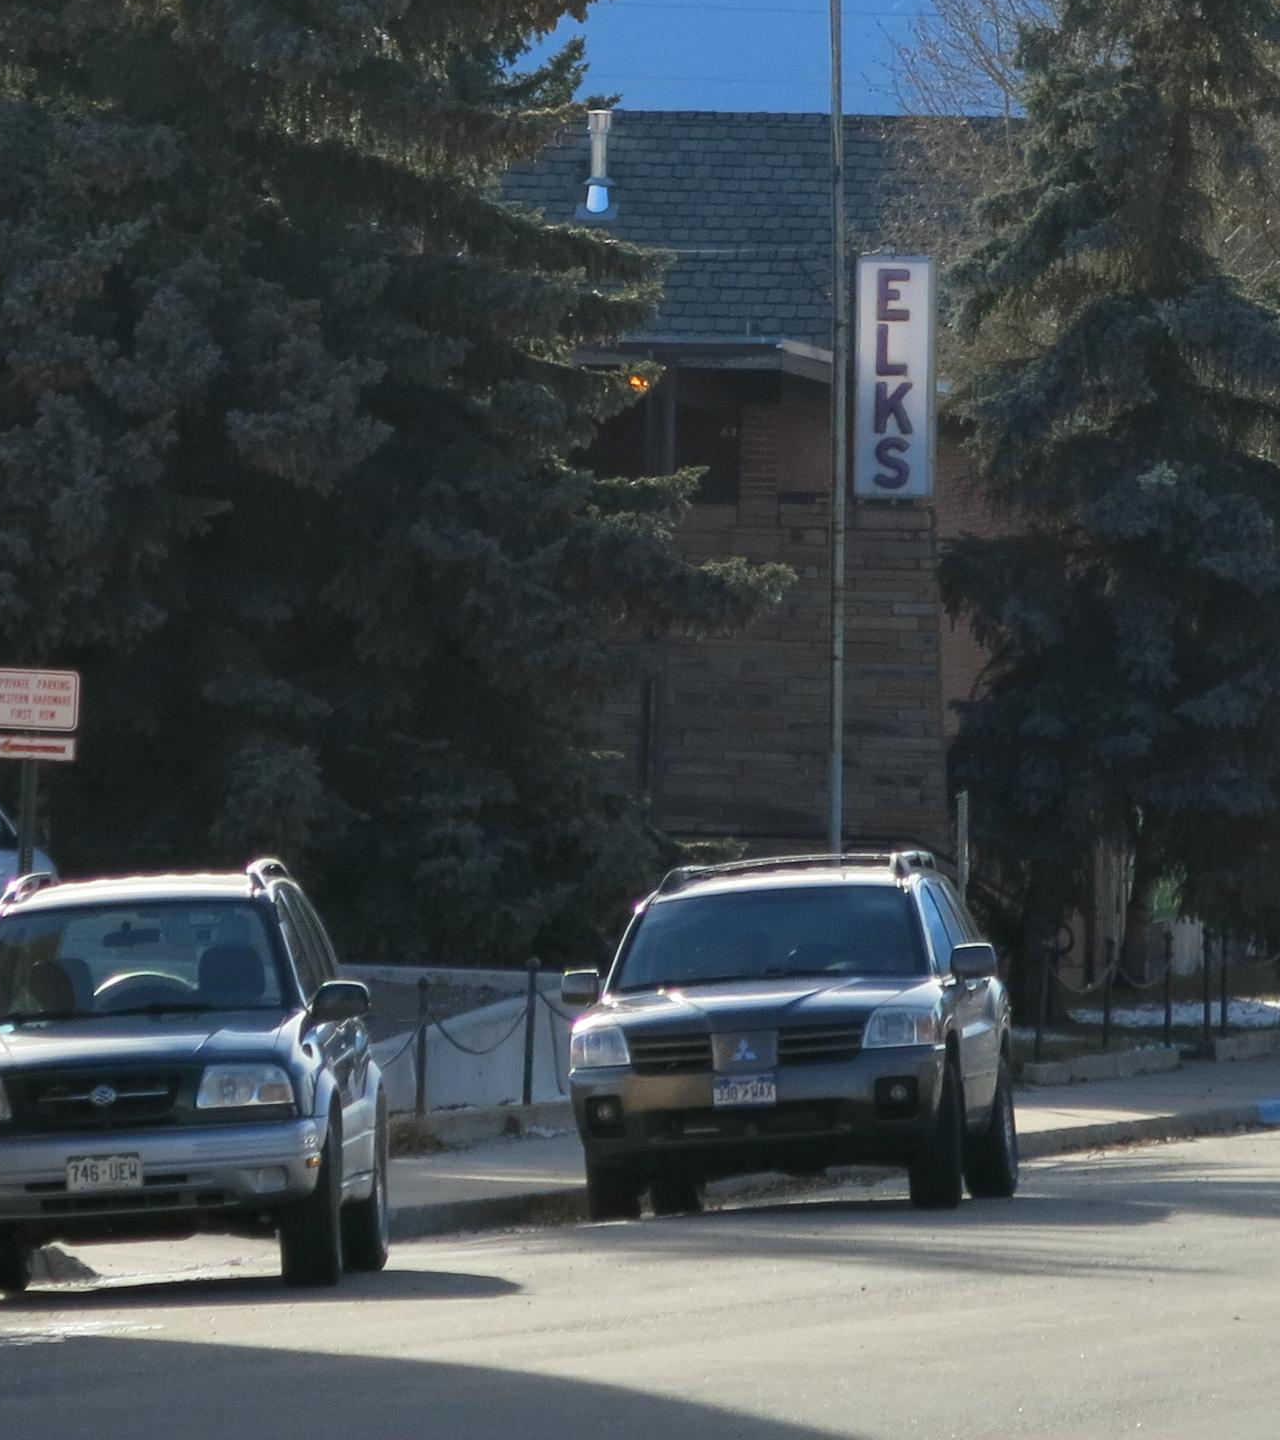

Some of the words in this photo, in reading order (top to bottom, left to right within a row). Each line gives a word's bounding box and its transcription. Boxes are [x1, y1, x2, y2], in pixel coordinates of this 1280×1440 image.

[873, 268, 913, 490] ELKS
[36, 679, 71, 691] PARKING
[10, 708, 32, 720] FIRST
[38, 709, 57, 721] ROW
